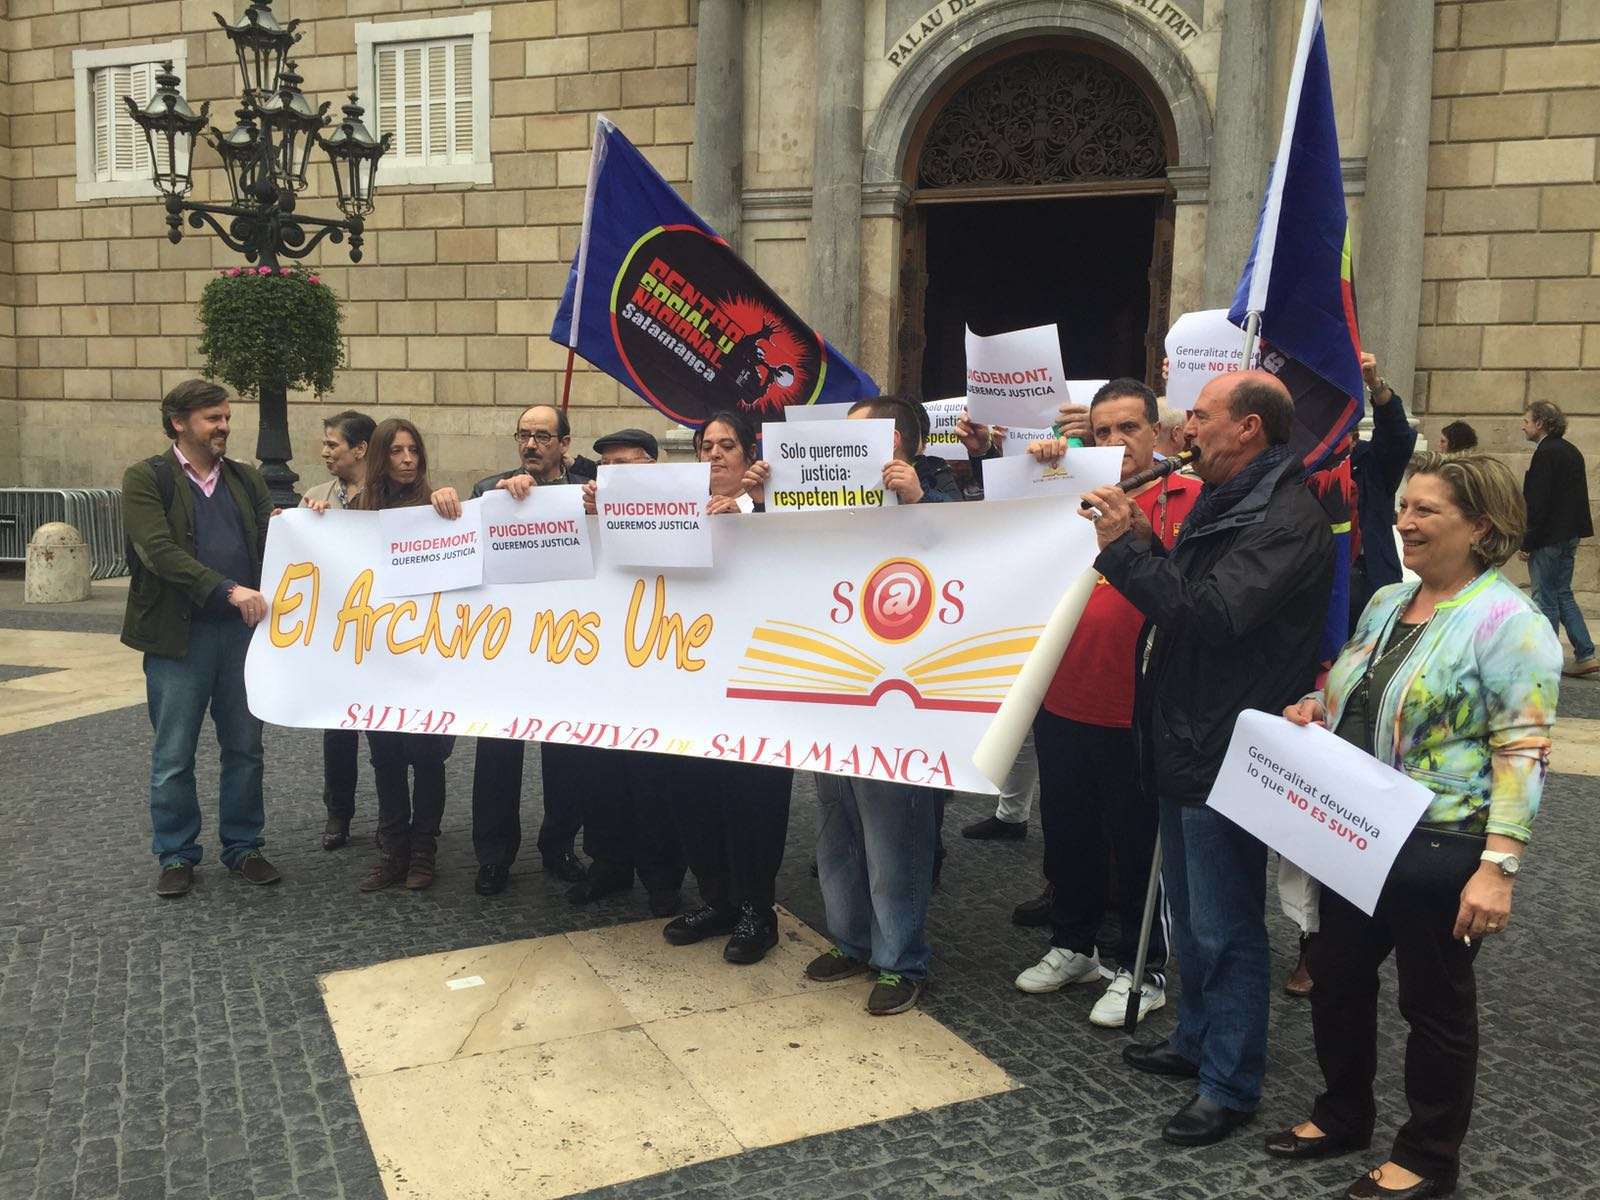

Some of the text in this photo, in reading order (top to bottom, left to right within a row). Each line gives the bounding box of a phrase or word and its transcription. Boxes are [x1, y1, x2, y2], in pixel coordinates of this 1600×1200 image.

[888, 9, 943, 67] PALAU
[648, 256, 746, 343] CENTRO
[621, 303, 716, 382] Salamanca
[1175, 345, 1229, 359] Generalitat
[968, 367, 1053, 385] IGDEMONT,
[1177, 359, 1186, 369] lo
[1188, 361, 1206, 372] que
[1208, 362, 1224, 371] NO
[1227, 363, 1239, 373] ES
[967, 384, 1055, 398] UEREMOS JUSTICIA
[1017, 431, 1045, 440] Archivo
[780, 442, 868, 462] Solo queremos
[800, 465, 851, 484] justicia:
[774, 485, 884, 510] respeten la ley
[604, 501, 700, 518] PUIGDEMONT,
[489, 520, 579, 538] PUIGDEMONT,
[606, 520, 700, 532] QUEREMOS JUSTICIA
[390, 531, 478, 555] PUIGDEMONT,
[491, 536, 580, 551] QUEREMOS JUSTICIA
[391, 546, 476, 567] QUEREMOS JUSTICIA
[268, 561, 714, 673] El Archivo nos Une
[340, 702, 456, 734] SALVAR
[501, 716, 660, 749] ARCHIVO
[703, 733, 956, 787] SALAMANCA
[1248, 745, 1381, 839] Generalitat devuelva
[1247, 763, 1369, 851] lo que NO ES SUYO
